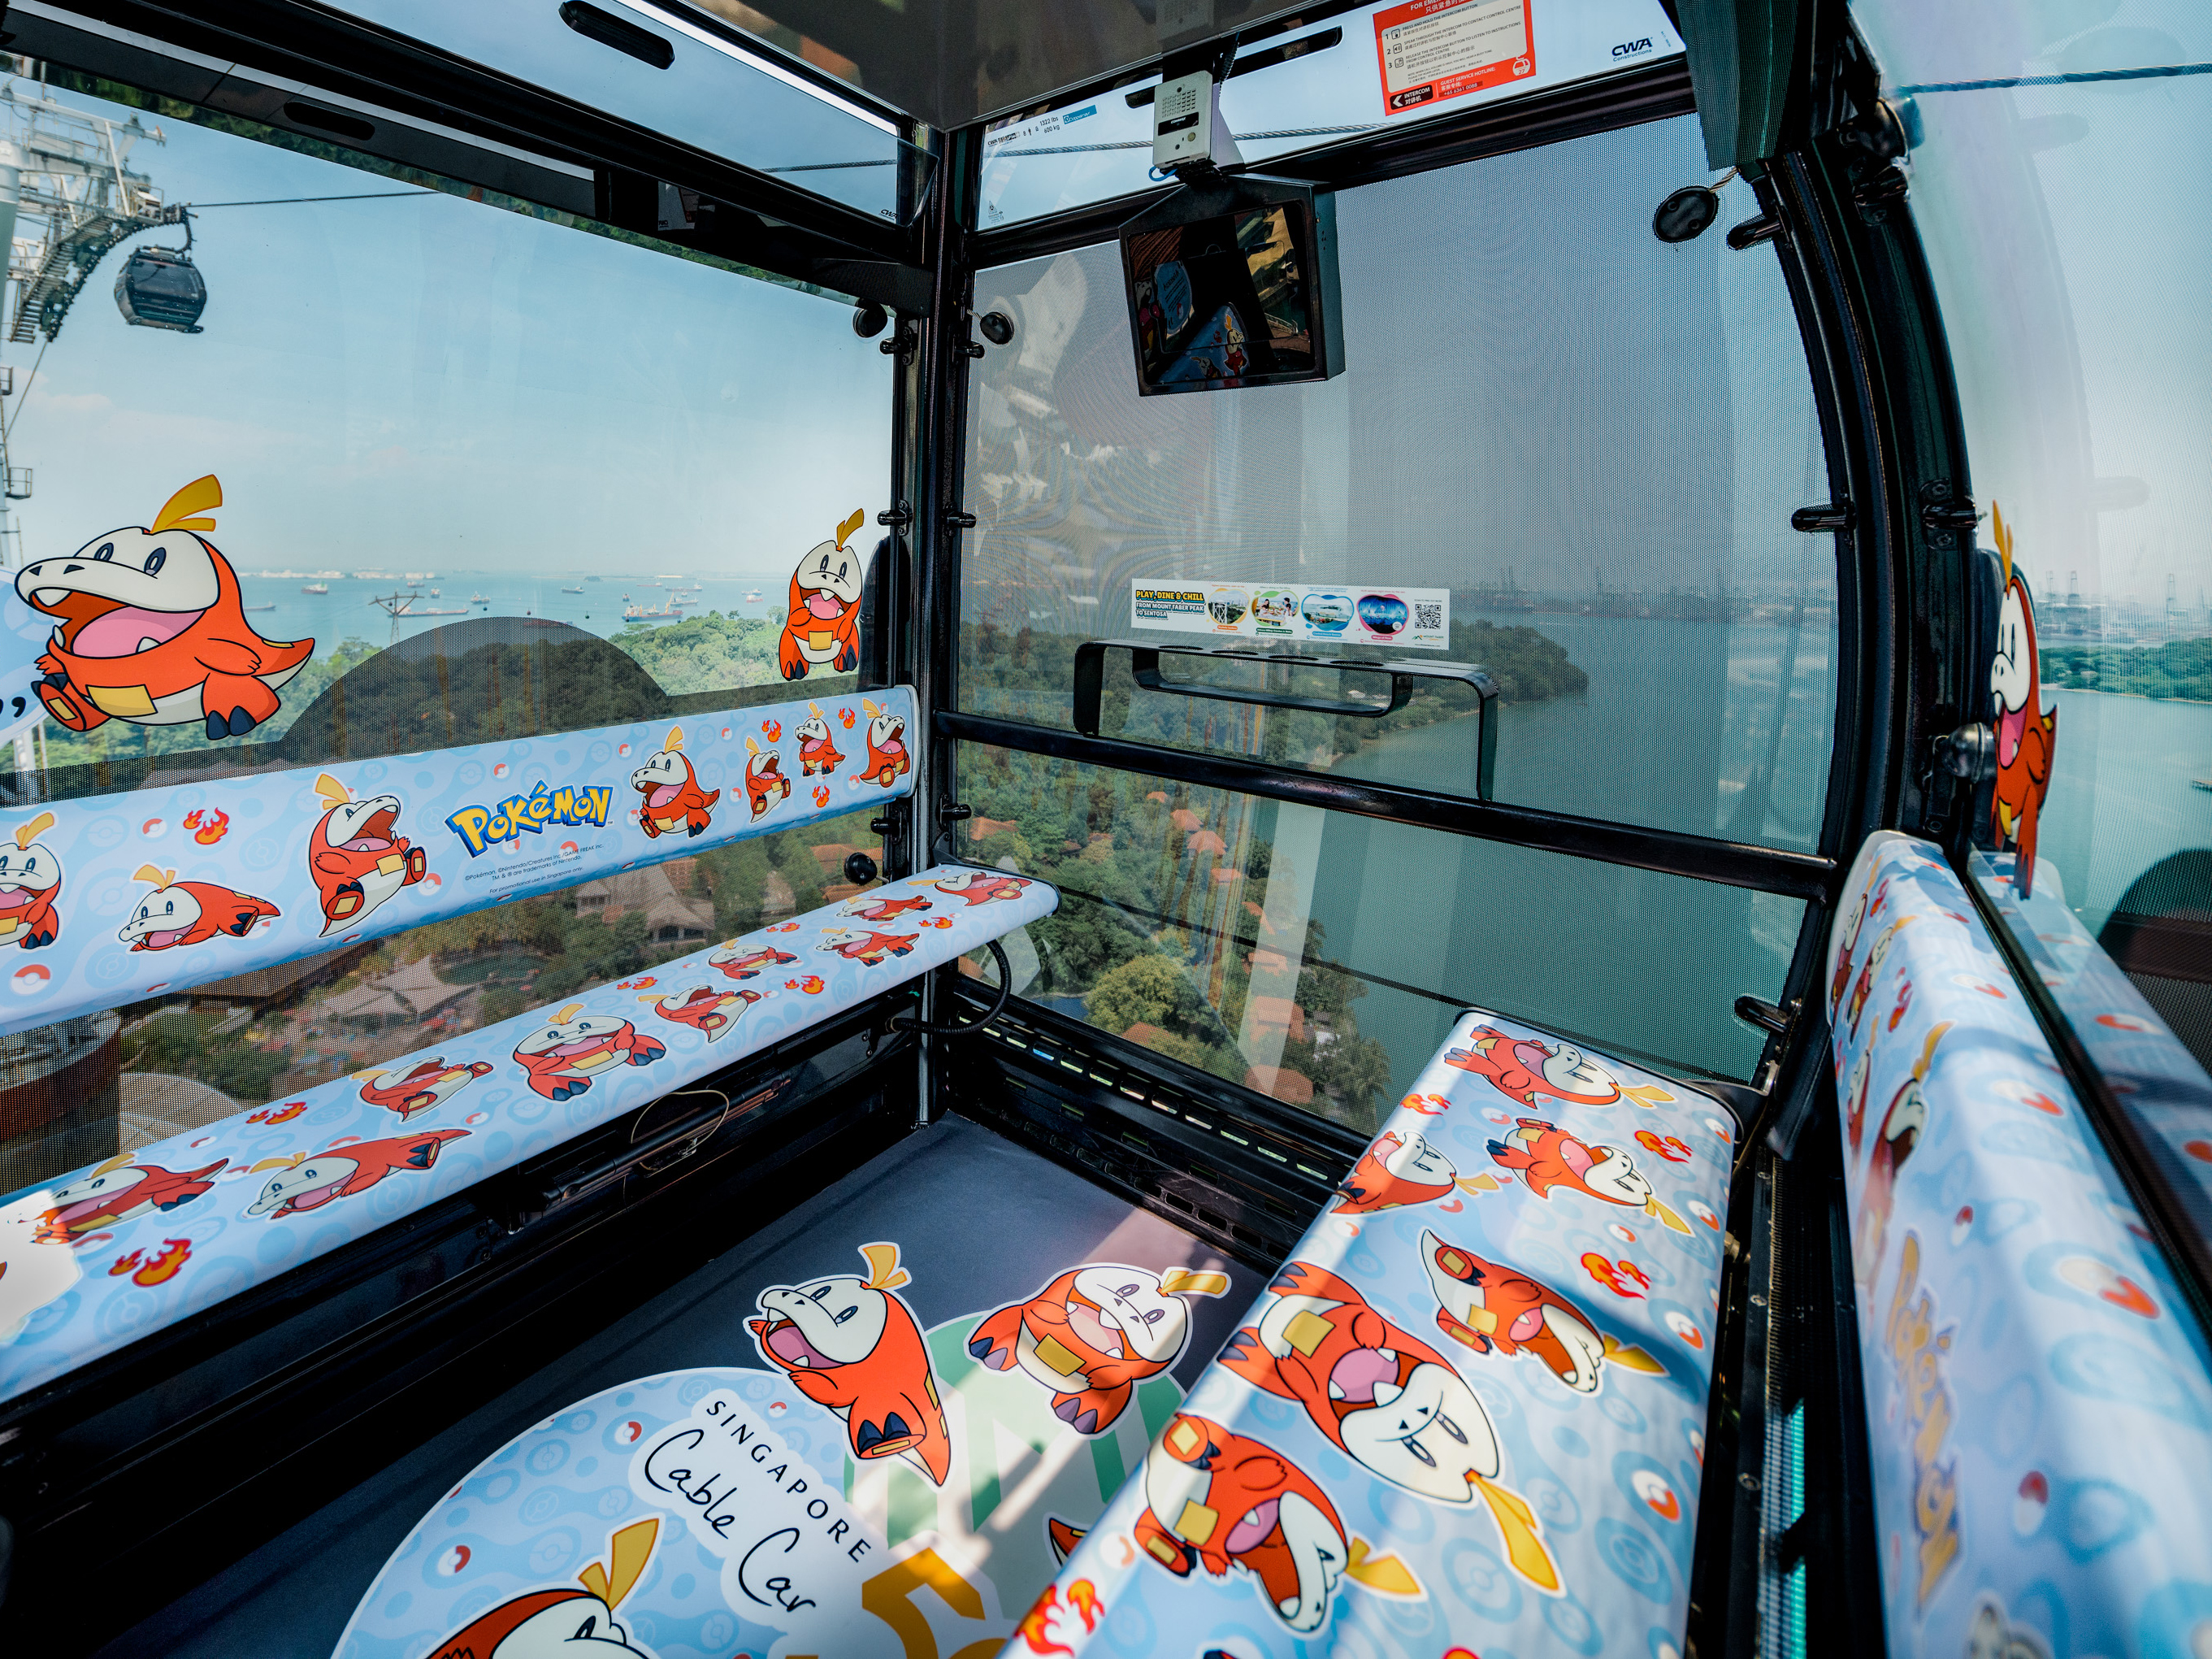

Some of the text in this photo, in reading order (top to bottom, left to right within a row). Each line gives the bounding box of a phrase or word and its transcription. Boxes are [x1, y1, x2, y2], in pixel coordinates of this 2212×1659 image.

[1410, 2, 1423, 11] FOR
[1442, 9, 1461, 19] INTERCOM
[1462, 3, 1477, 12] BUTTON
[1442, 24, 1461, 33] INTERCOM
[1468, 16, 1486, 25] CONTACT
[1486, 11, 1505, 20] CONTROL
[1505, 5, 1521, 14] CENTRE
[1406, 51, 1421, 59] RELEASE
[1429, 43, 1448, 52] INTERCOM
[1450, 38, 1464, 46] BUTTON
[1472, 32, 1485, 40] LISTEN
[1491, 21, 1521, 33] INSTRUCTIONS
[1611, 37, 1653, 57] CWA
[1417, 52, 1434, 60] CONTROL
[1613, 49, 1652, 62] Constructions
[1440, 66, 1496, 85] GUEST SERVICE HOTLINE:
[1403, 86, 1430, 98] INTERCOM
[1453, 86, 1465, 94] 6361
[1465, 82, 1478, 90] 0088
[1039, 118, 1051, 127] 1322
[1043, 124, 1060, 134] 600 kg
[1136, 590, 1204, 603] PLAY, DINE & CHILL
[1136, 601, 1152, 610] FROM
[1152, 602, 1171, 610] MOUNT
[1189, 605, 1204, 613] PEAK
[1143, 610, 1168, 619] SENTOSA
[498, 856, 553, 873] ©Nintendo/Creatures
[523, 862, 552, 875] trademarks
[558, 855, 582, 866] Nintendo.
[498, 879, 531, 893] promotional
[546, 869, 572, 880] Singapore
[572, 866, 584, 874] only.
[644, 1428, 738, 1540] Cable
[706, 1401, 871, 1563] SINGAPORE
[738, 1527, 817, 1613] Car
